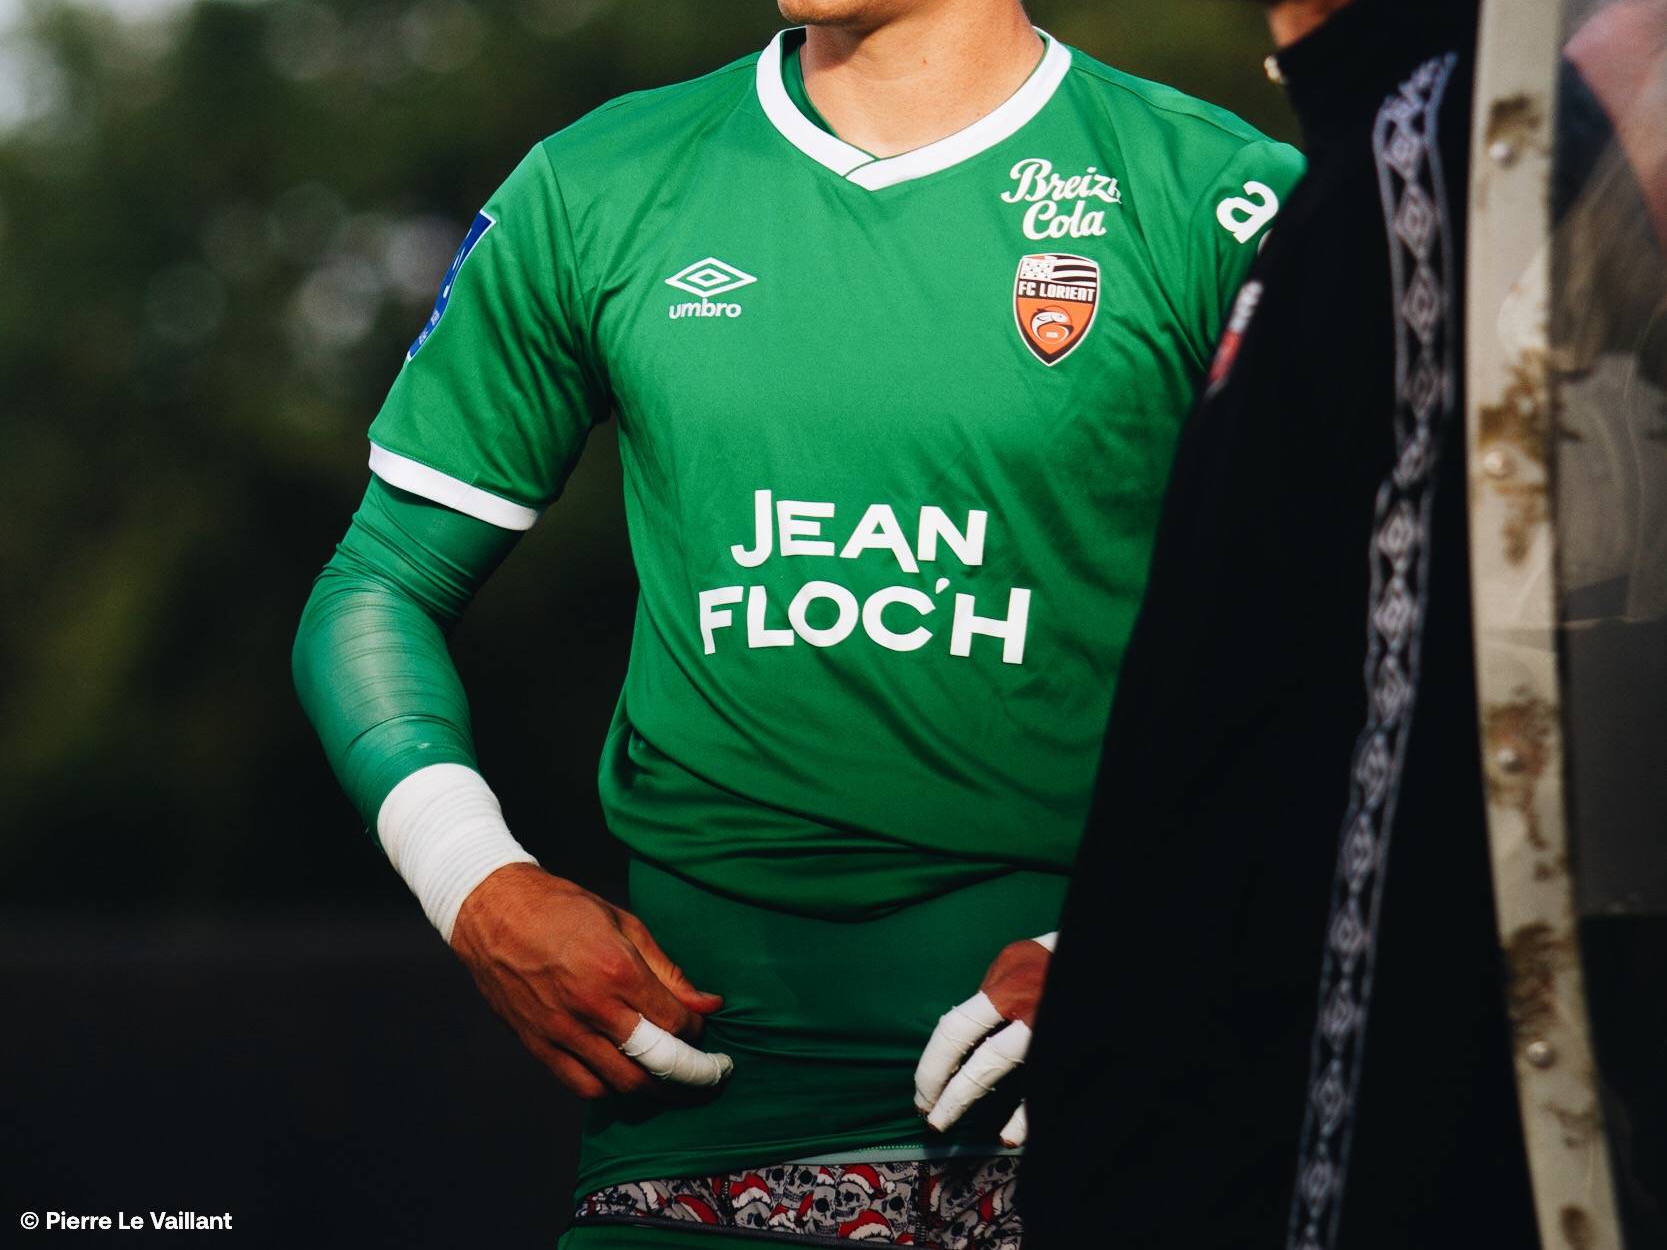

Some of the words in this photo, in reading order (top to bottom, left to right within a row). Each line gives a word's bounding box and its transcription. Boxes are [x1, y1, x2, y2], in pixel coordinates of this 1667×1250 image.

[1022, 200, 1107, 240] Cola
[669, 298, 742, 319] umbro
[1018, 281, 1036, 297] FC
[1039, 284, 1095, 302] LORIENT
[731, 489, 988, 573] JEAN
[699, 578, 1031, 664] FLOC'H
